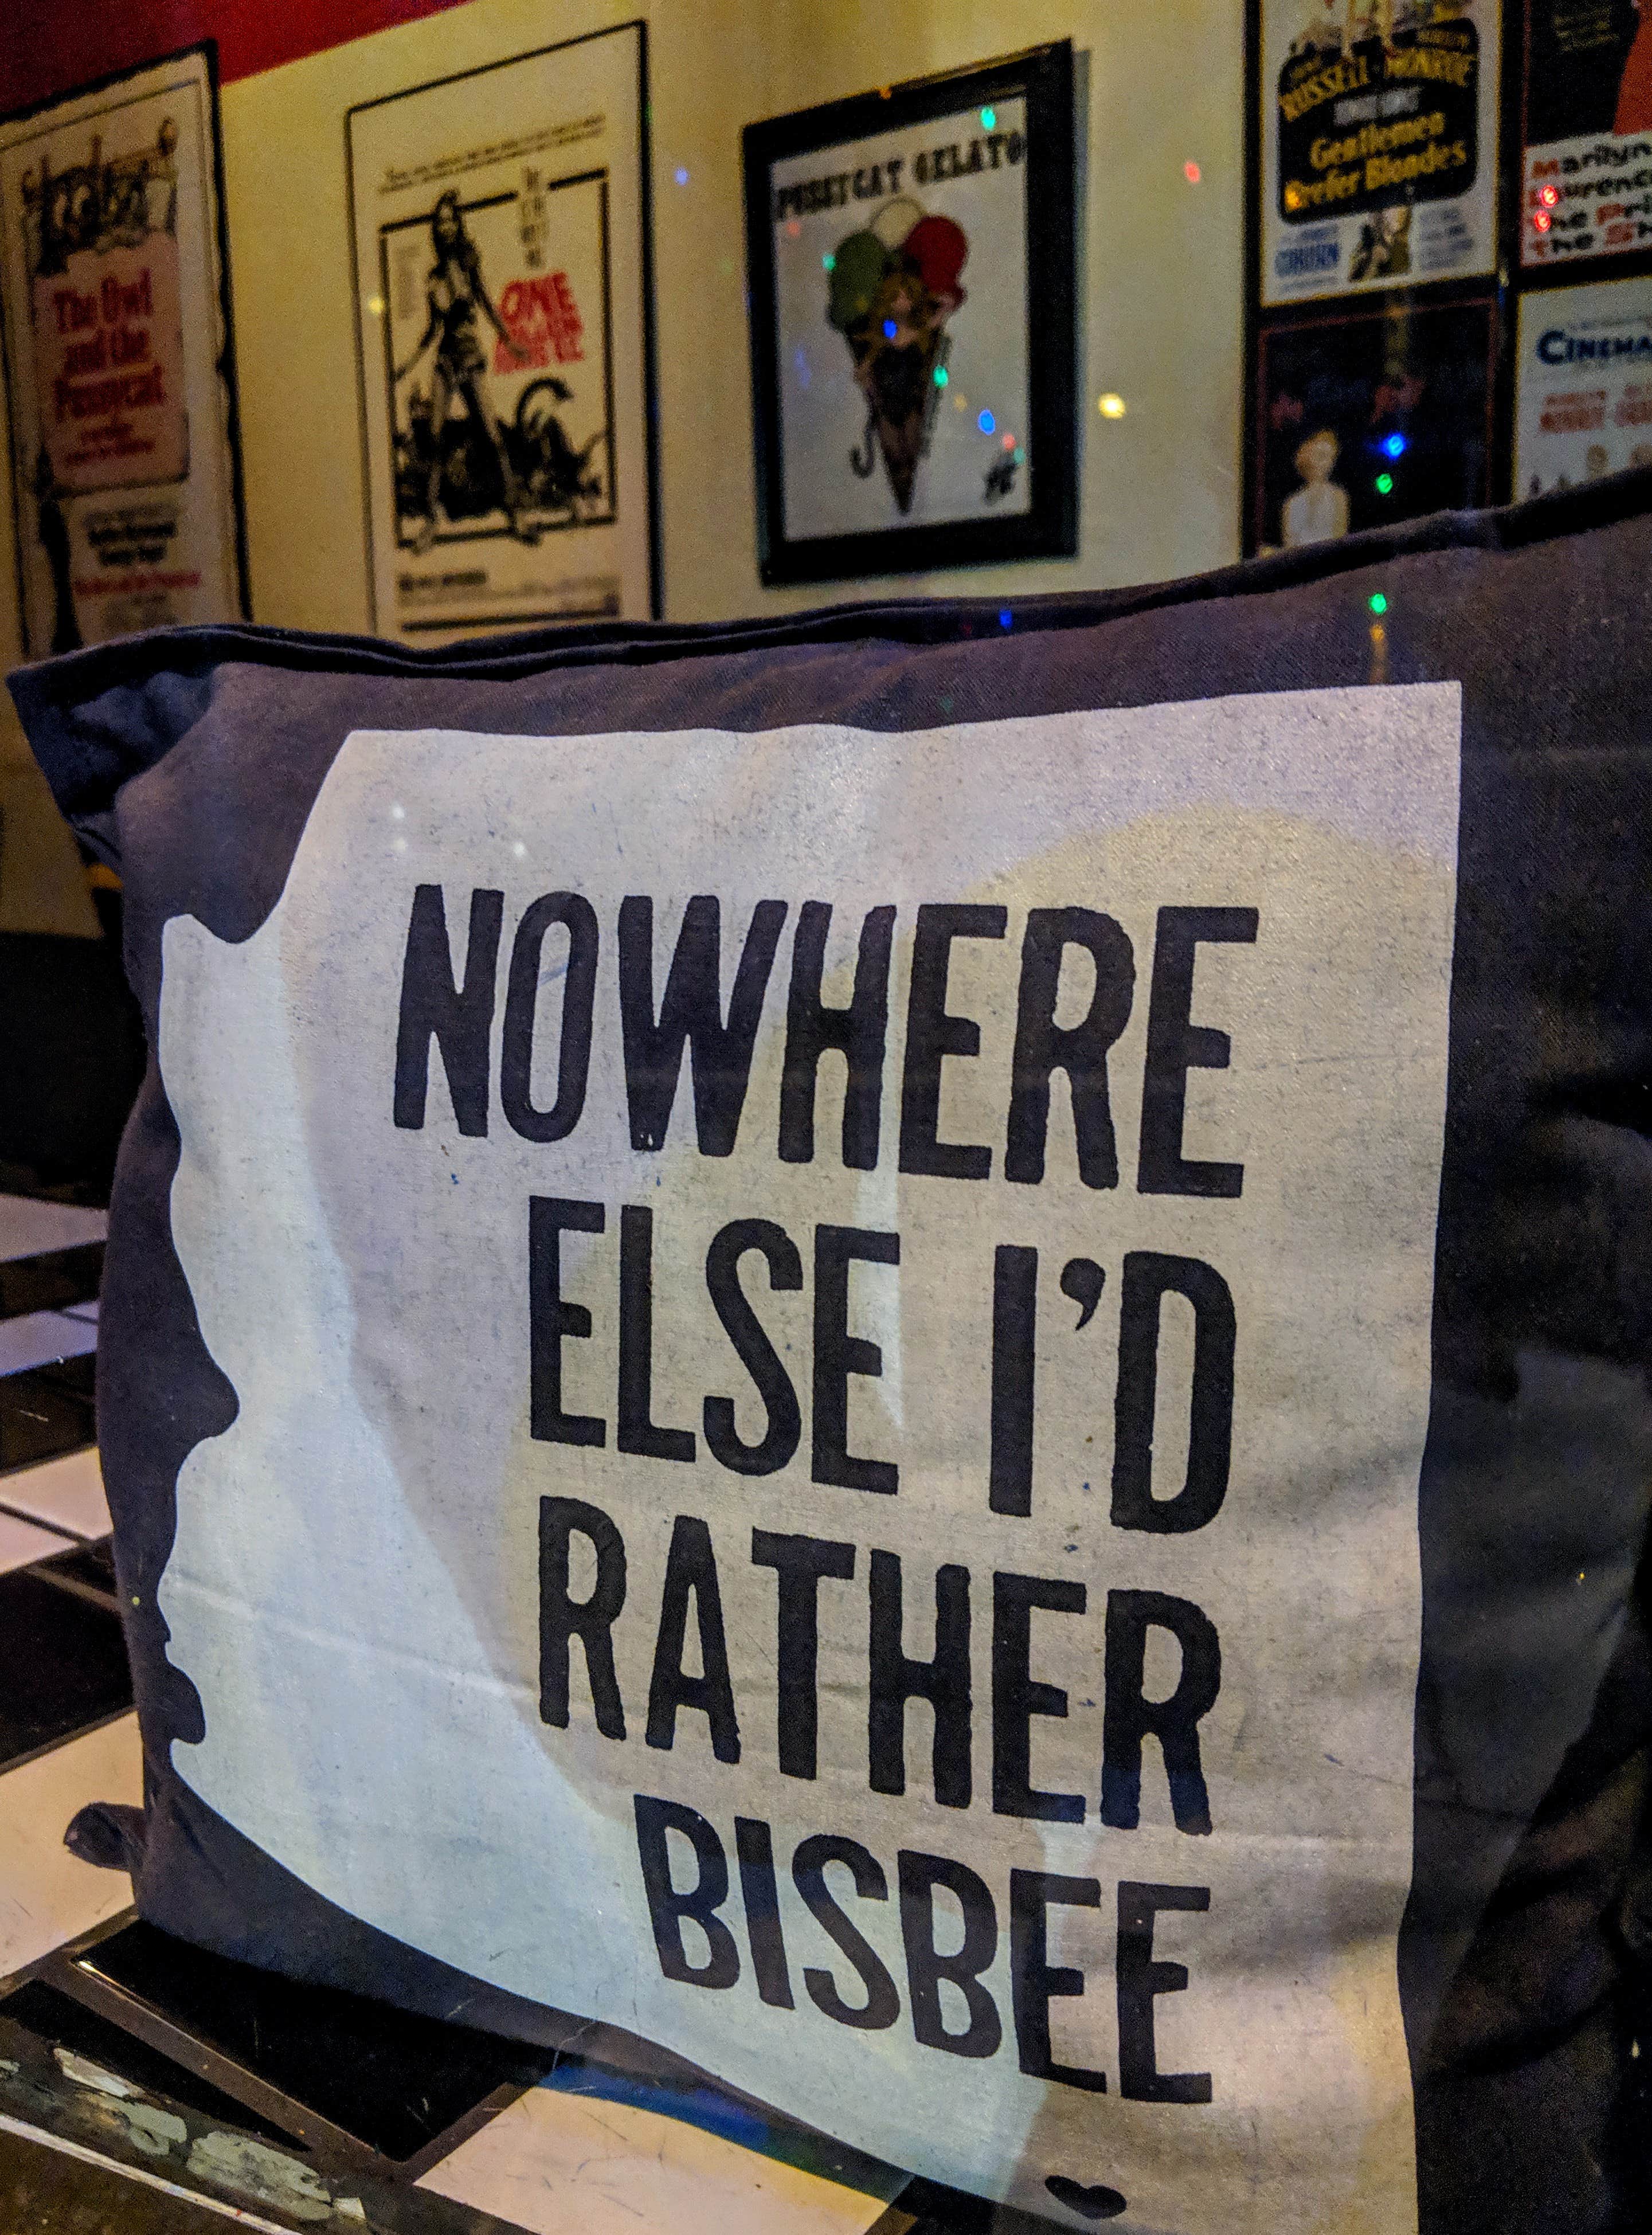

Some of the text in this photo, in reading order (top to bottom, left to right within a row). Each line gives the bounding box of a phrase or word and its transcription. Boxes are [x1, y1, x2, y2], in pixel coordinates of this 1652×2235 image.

[500, 271, 577, 326] ONE
[393, 884, 1259, 1198] NOWHERE
[530, 1195, 1237, 1535] ELSE I'D
[538, 1495, 1222, 1835] RATHER
[633, 1794, 1212, 2104] BISBEE
